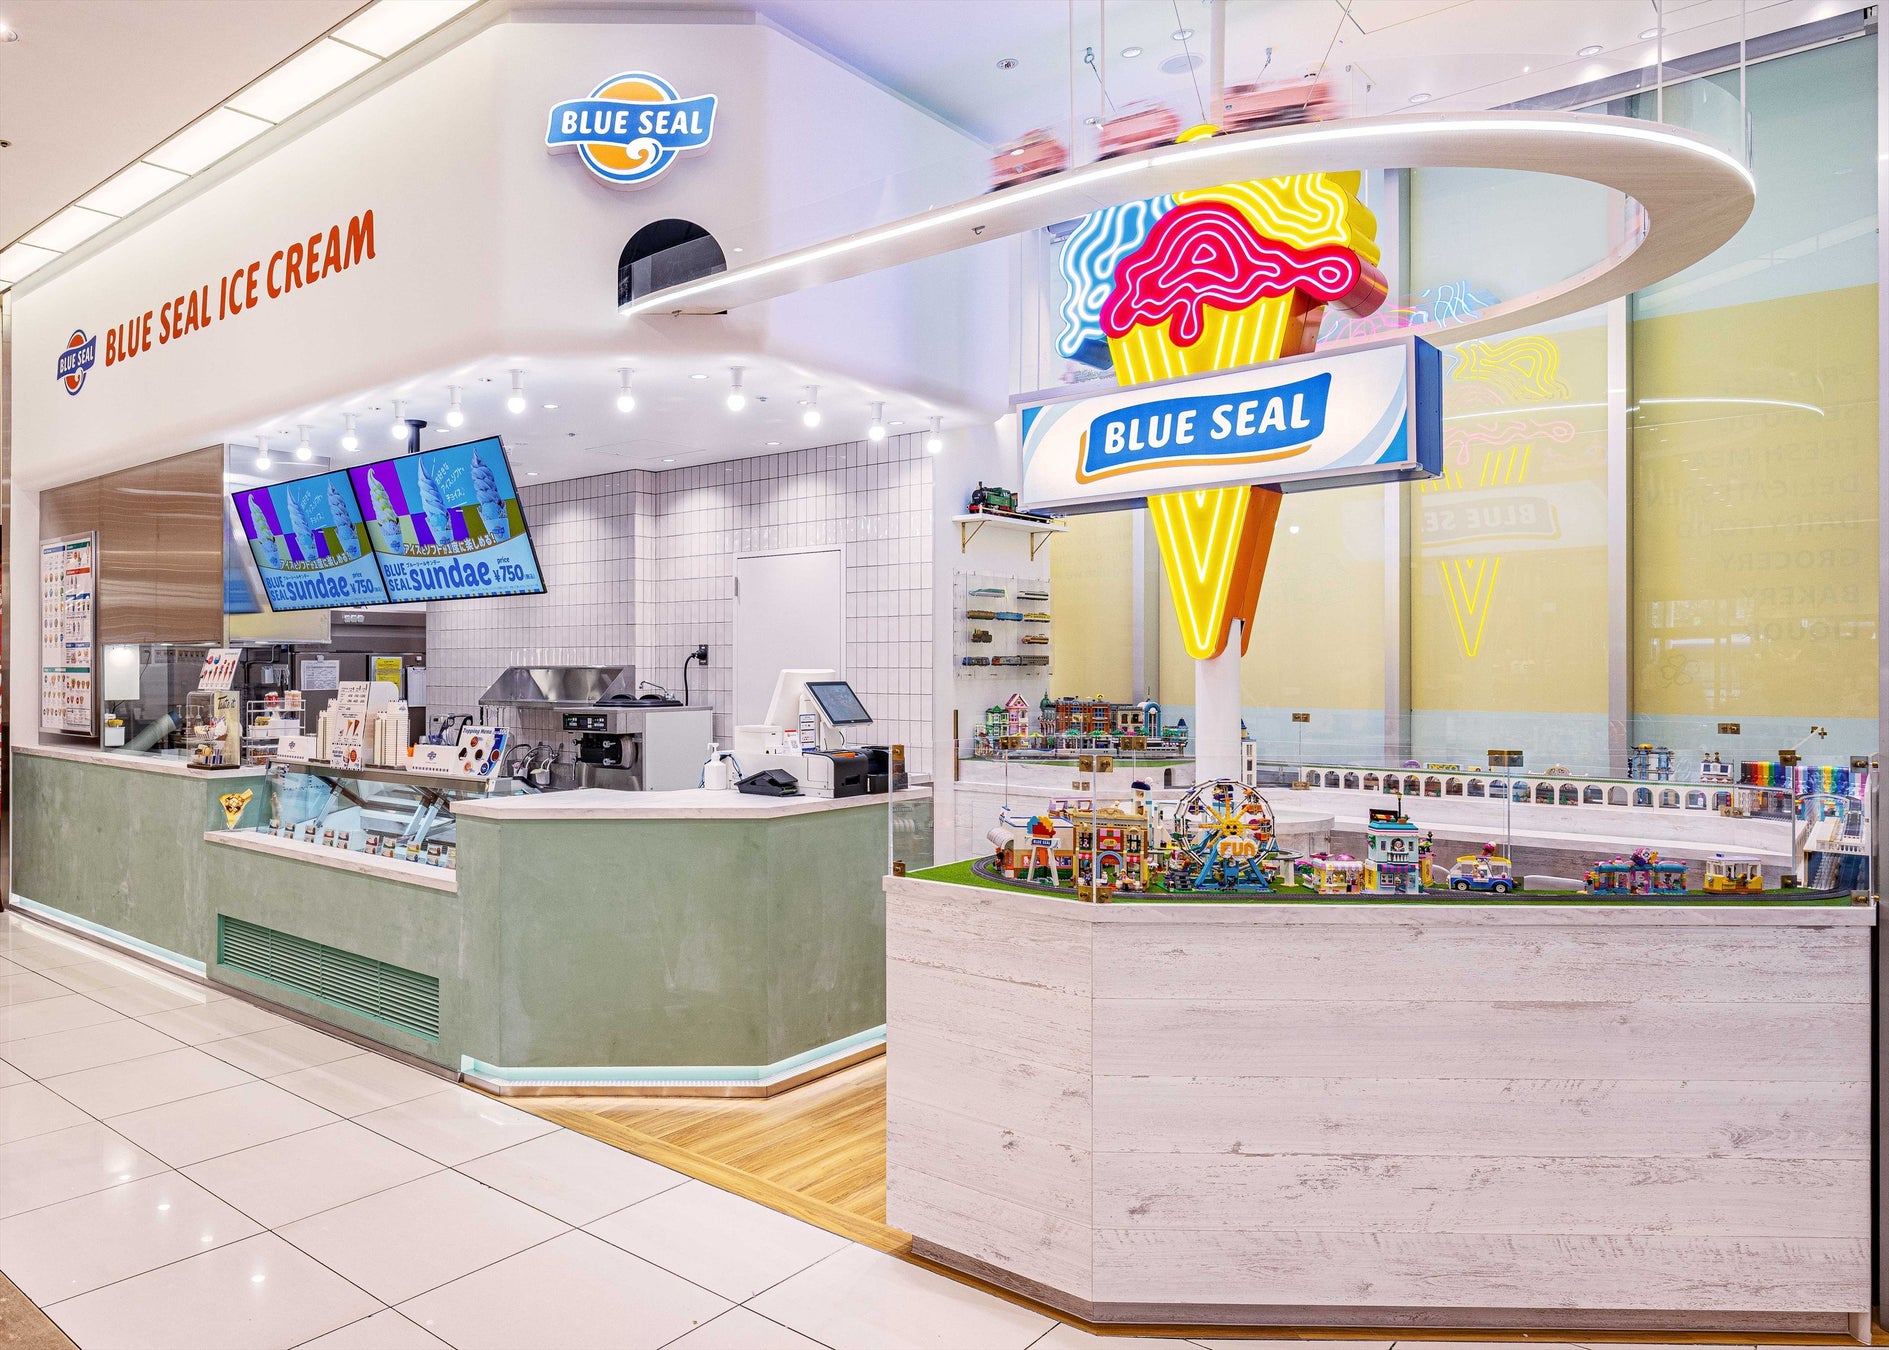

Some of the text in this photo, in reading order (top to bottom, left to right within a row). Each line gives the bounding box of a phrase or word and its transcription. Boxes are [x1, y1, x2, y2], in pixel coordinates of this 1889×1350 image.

[561, 110, 704, 135] BLUE SEAL
[105, 209, 376, 367] BLUE SEAL ICE CREAM
[59, 346, 94, 373] BLUE SEAL
[1104, 393, 1311, 454] BLUE SEAL
[496, 556, 510, 565] price
[384, 563, 407, 577] BLUE
[409, 557, 492, 591] sundae
[493, 564, 524, 582] ¥750
[265, 576, 284, 589] BLUE
[286, 572, 350, 602] sundae
[351, 579, 374, 594] ¥750
[388, 578, 412, 592] SEAL
[271, 588, 289, 601] SEAL
